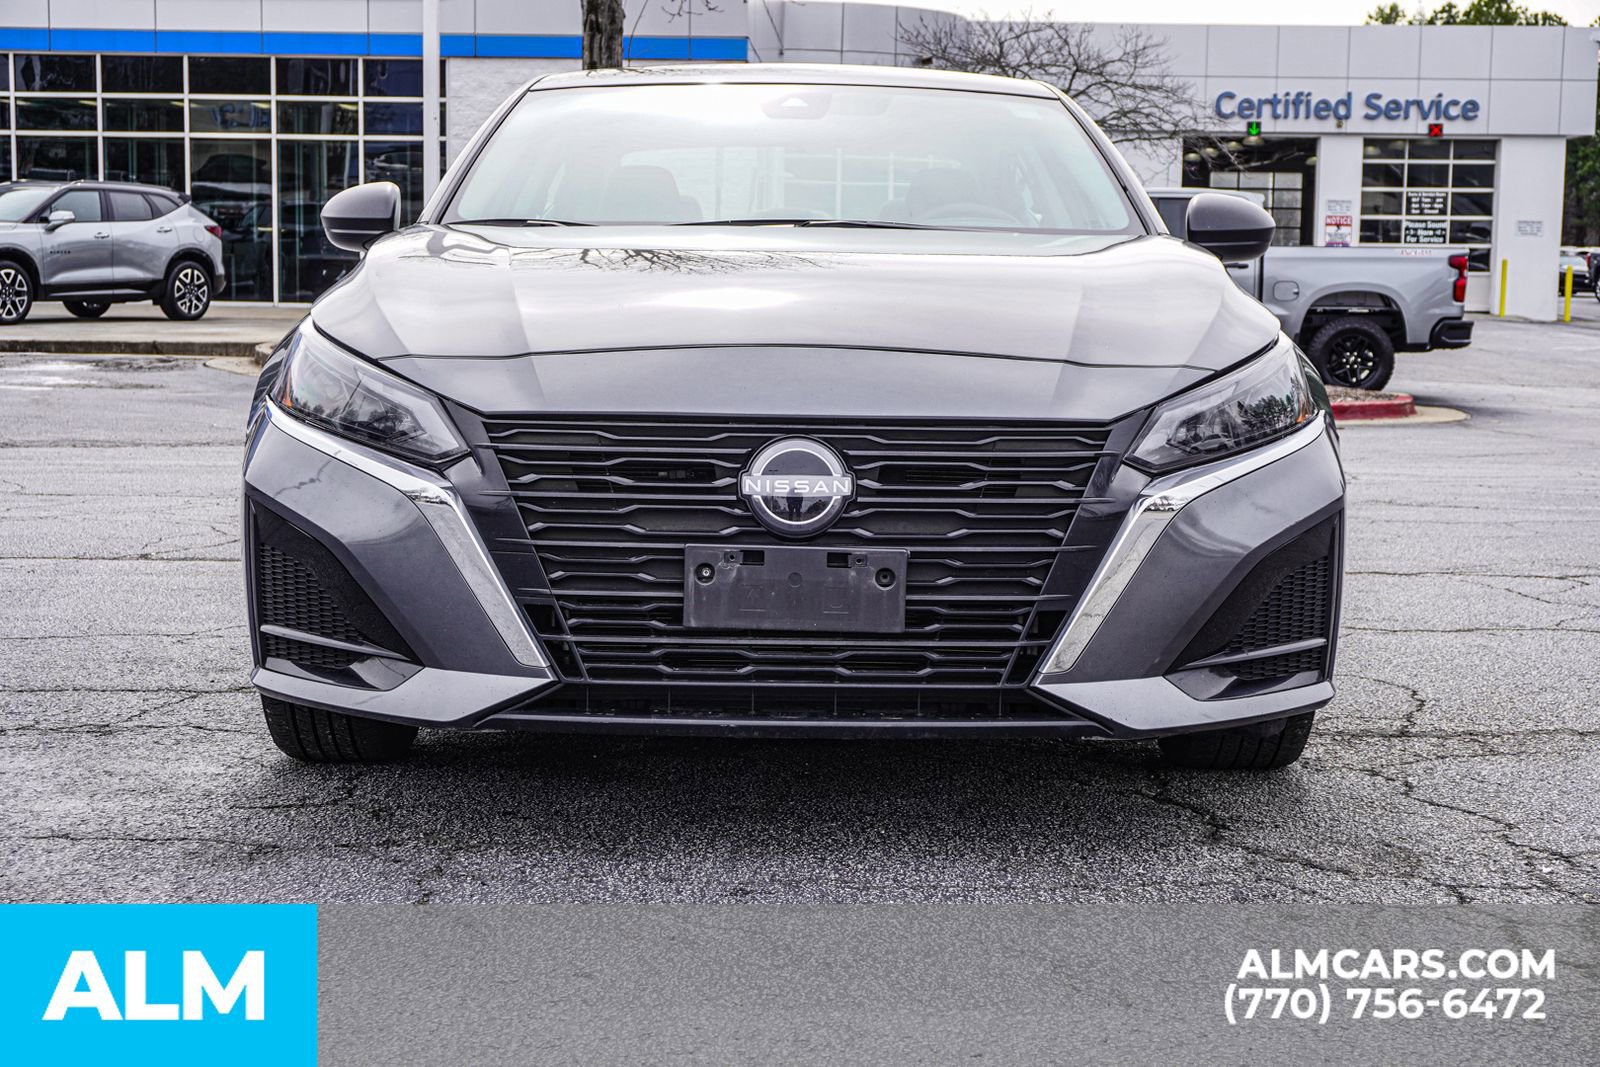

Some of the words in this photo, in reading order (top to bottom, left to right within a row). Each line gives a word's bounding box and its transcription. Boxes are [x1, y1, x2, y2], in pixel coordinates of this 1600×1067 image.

[1215, 91, 1352, 120] Certified
[1363, 93, 1480, 121] Service
[1326, 216, 1352, 224] NOTICE
[1406, 235, 1418, 243] For
[1419, 235, 1444, 243] Service
[744, 479, 849, 493] NISSAN
